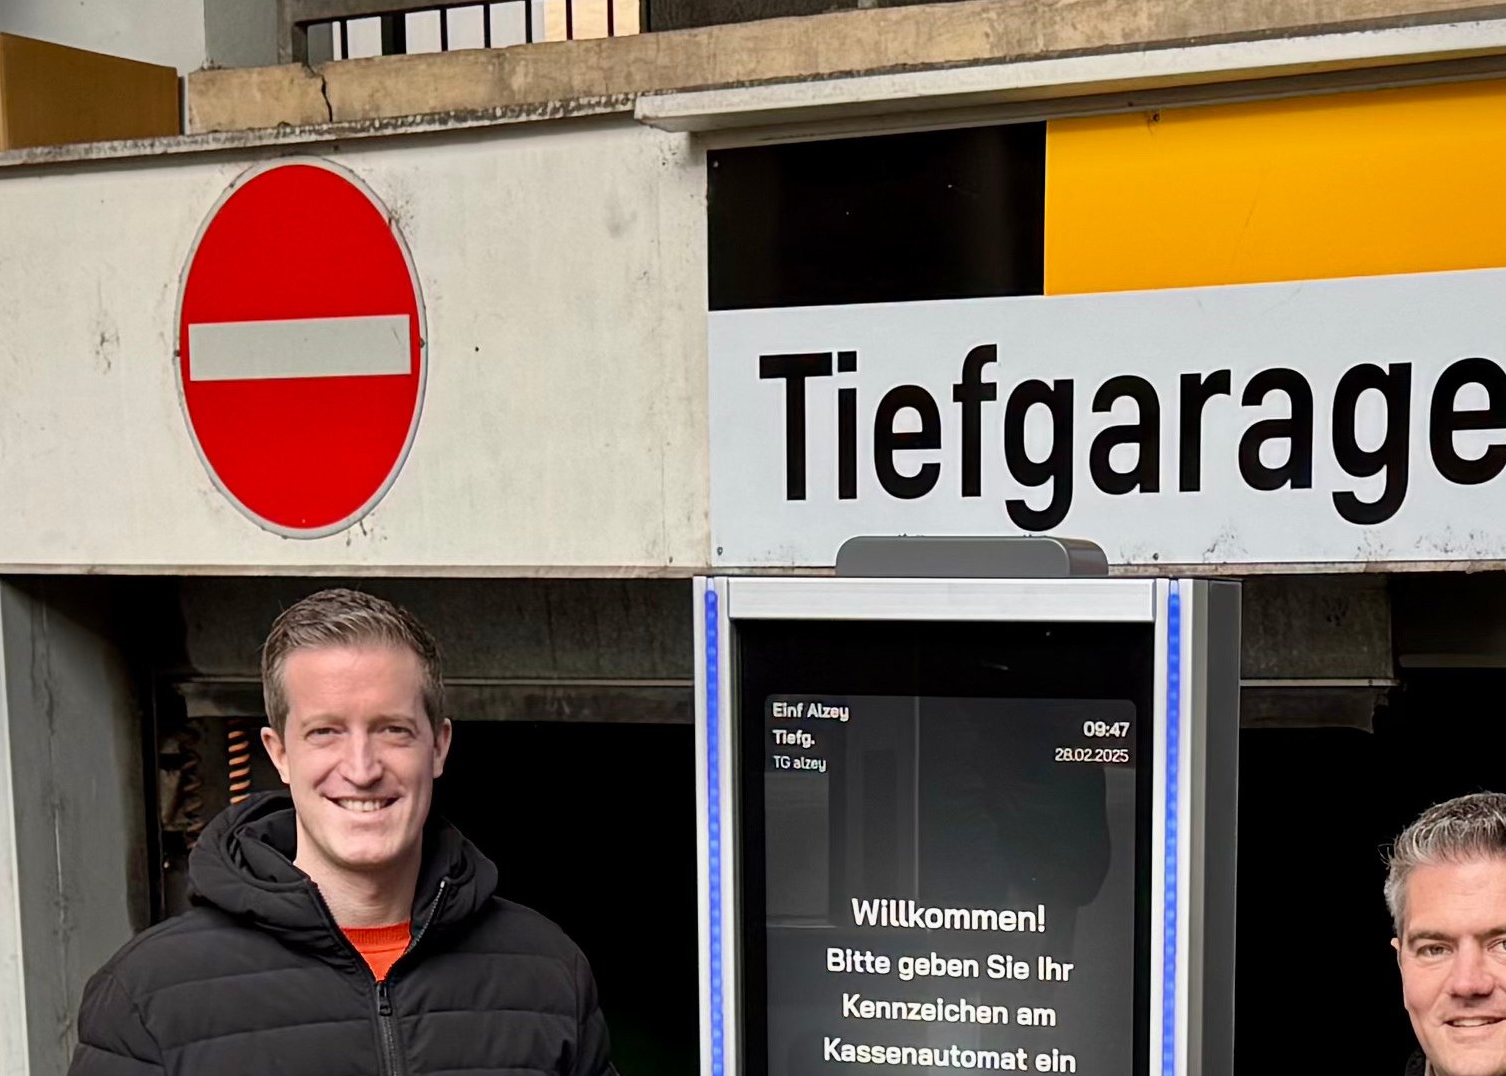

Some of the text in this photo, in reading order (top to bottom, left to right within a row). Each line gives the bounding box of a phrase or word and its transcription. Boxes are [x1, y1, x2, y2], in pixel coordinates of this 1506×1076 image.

[772, 702, 850, 723] Einf Alzey
[772, 729, 816, 749] Tiefg.
[1083, 720, 1130, 738] 09:47
[773, 755, 827, 773] TG alzey
[1054, 747, 1130, 763] 28.02.2025
[851, 897, 1046, 933] Willkommen!
[826, 947, 1075, 982] Bitte geben Sie Ihr
[842, 992, 1057, 1027] Kennzeichen am
[823, 1036, 1077, 1074] Kassenautomat ein
